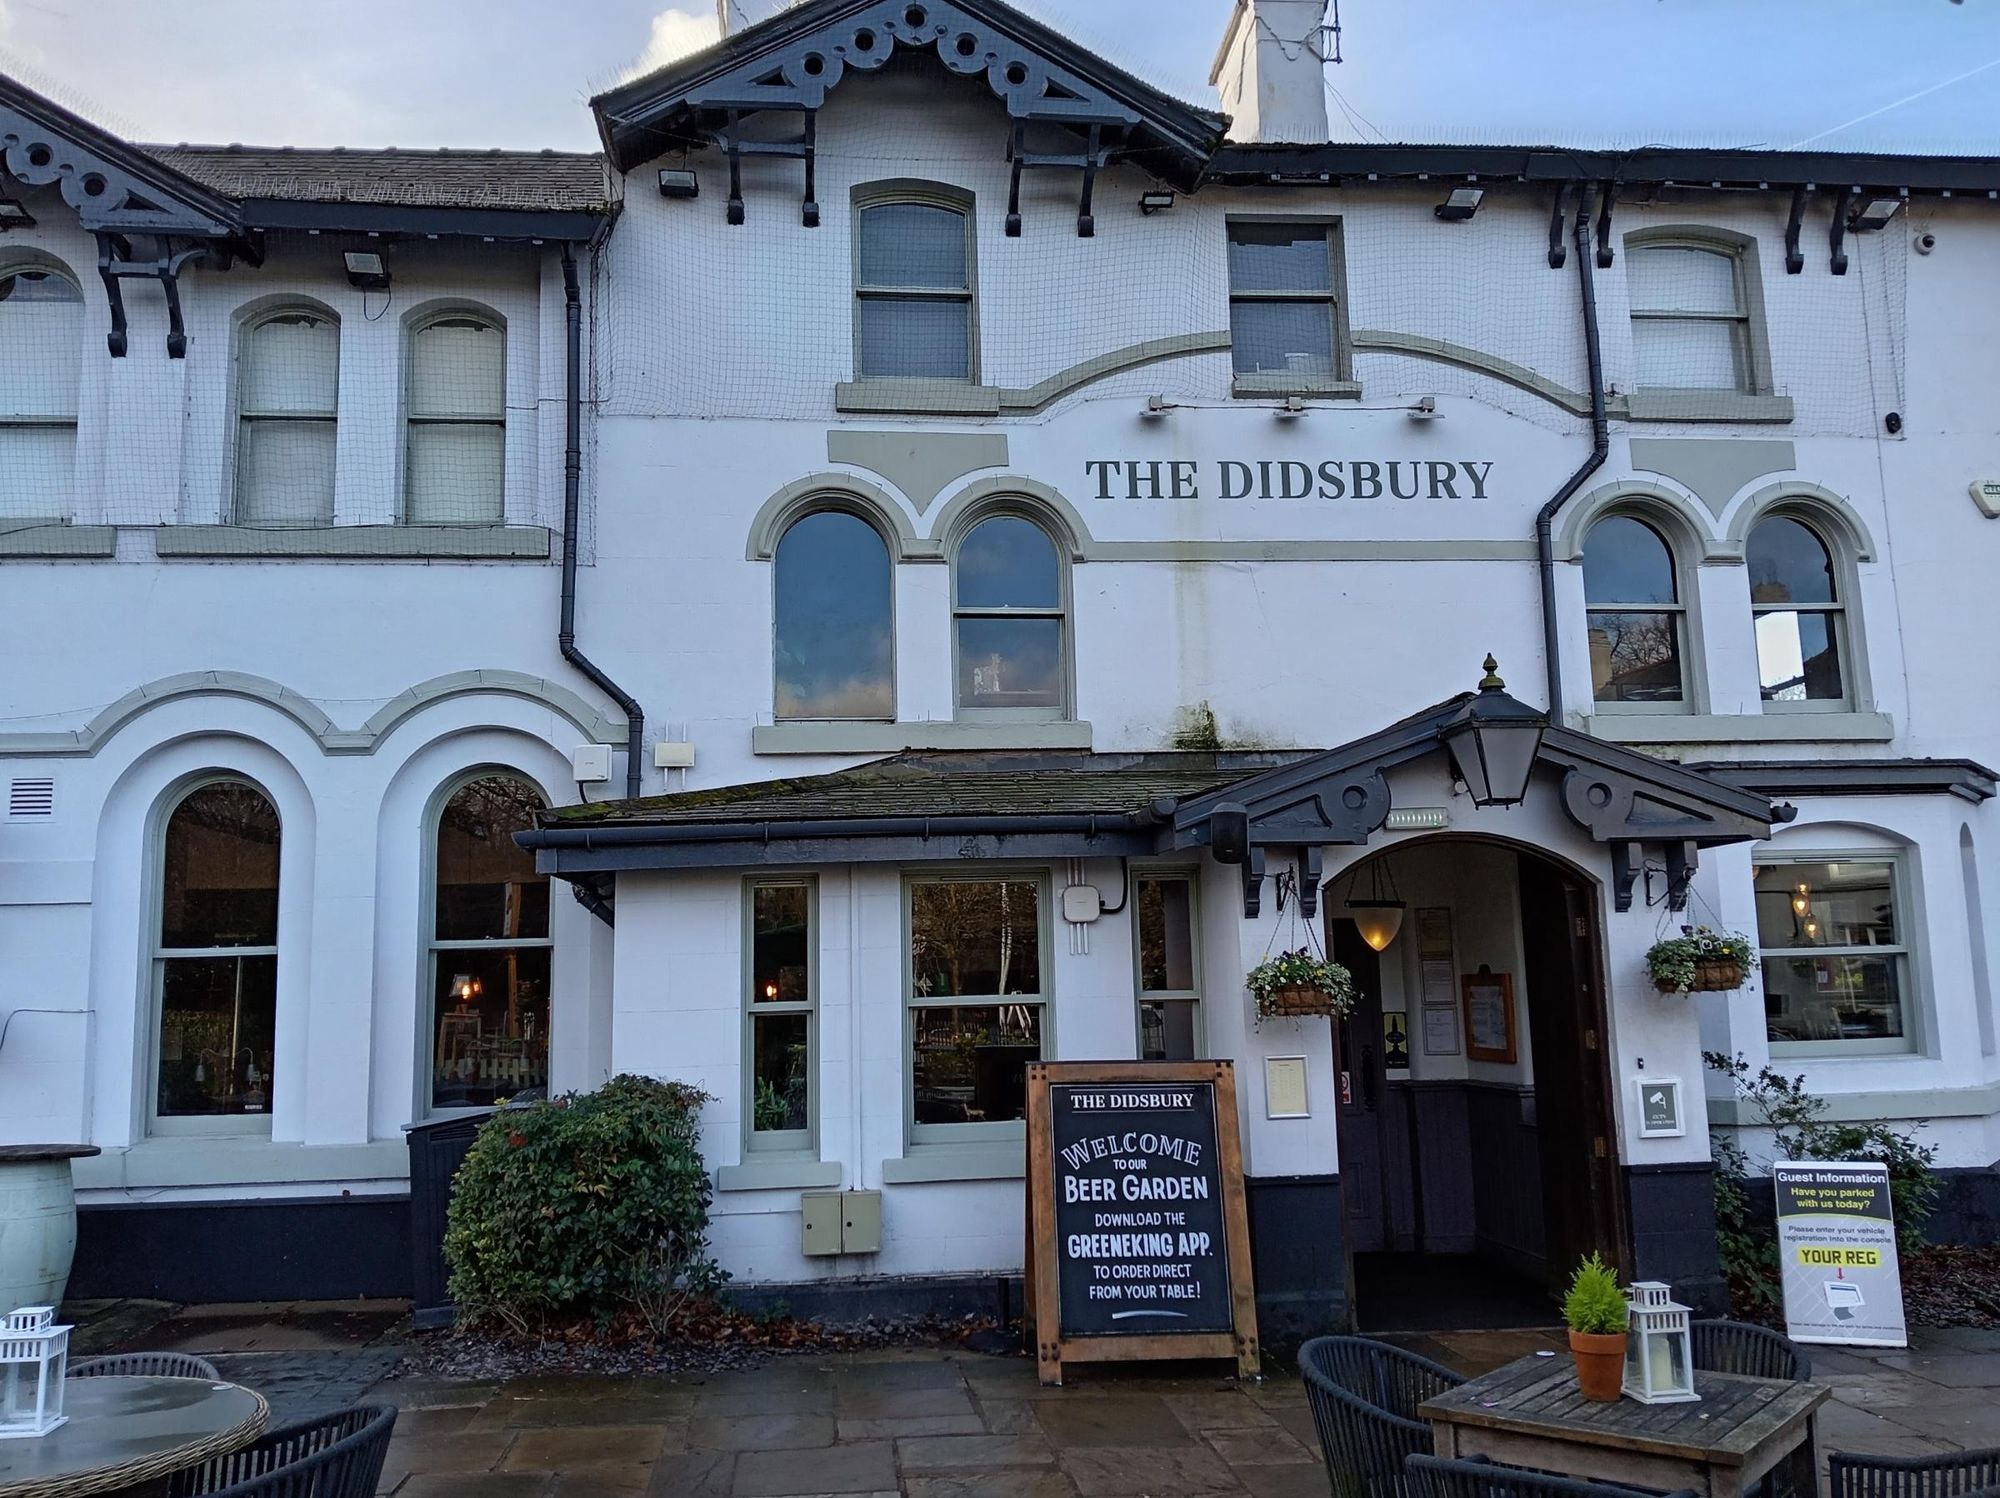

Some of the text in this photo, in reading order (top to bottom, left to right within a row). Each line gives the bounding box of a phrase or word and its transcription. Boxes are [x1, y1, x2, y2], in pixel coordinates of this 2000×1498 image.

[1085, 460, 1494, 500] THE DIDSBURY
[1070, 1093, 1194, 1109] THE DIDSBURY
[1060, 1131, 1202, 1170] WELCOME
[1113, 1158, 1147, 1170] TO OUR
[1777, 1171, 1886, 1184] Guest Information
[1064, 1174, 1209, 1203] BEER GARDEN
[1790, 1187, 1875, 1198] Have you parked
[1796, 1199, 1871, 1210] with us today?
[1094, 1212, 1186, 1227] DOWNLOAD THE
[1788, 1225, 1886, 1235] Please enter your vehicle
[1067, 1232, 1214, 1259] GREENEKING APP.
[1783, 1234, 1892, 1244] registration into the console
[1801, 1249, 1877, 1265] YOUR REG
[1093, 1263, 1192, 1279] TO ORDER DIRECT
[1089, 1280, 1202, 1300] FROM YOUR TABLE!
